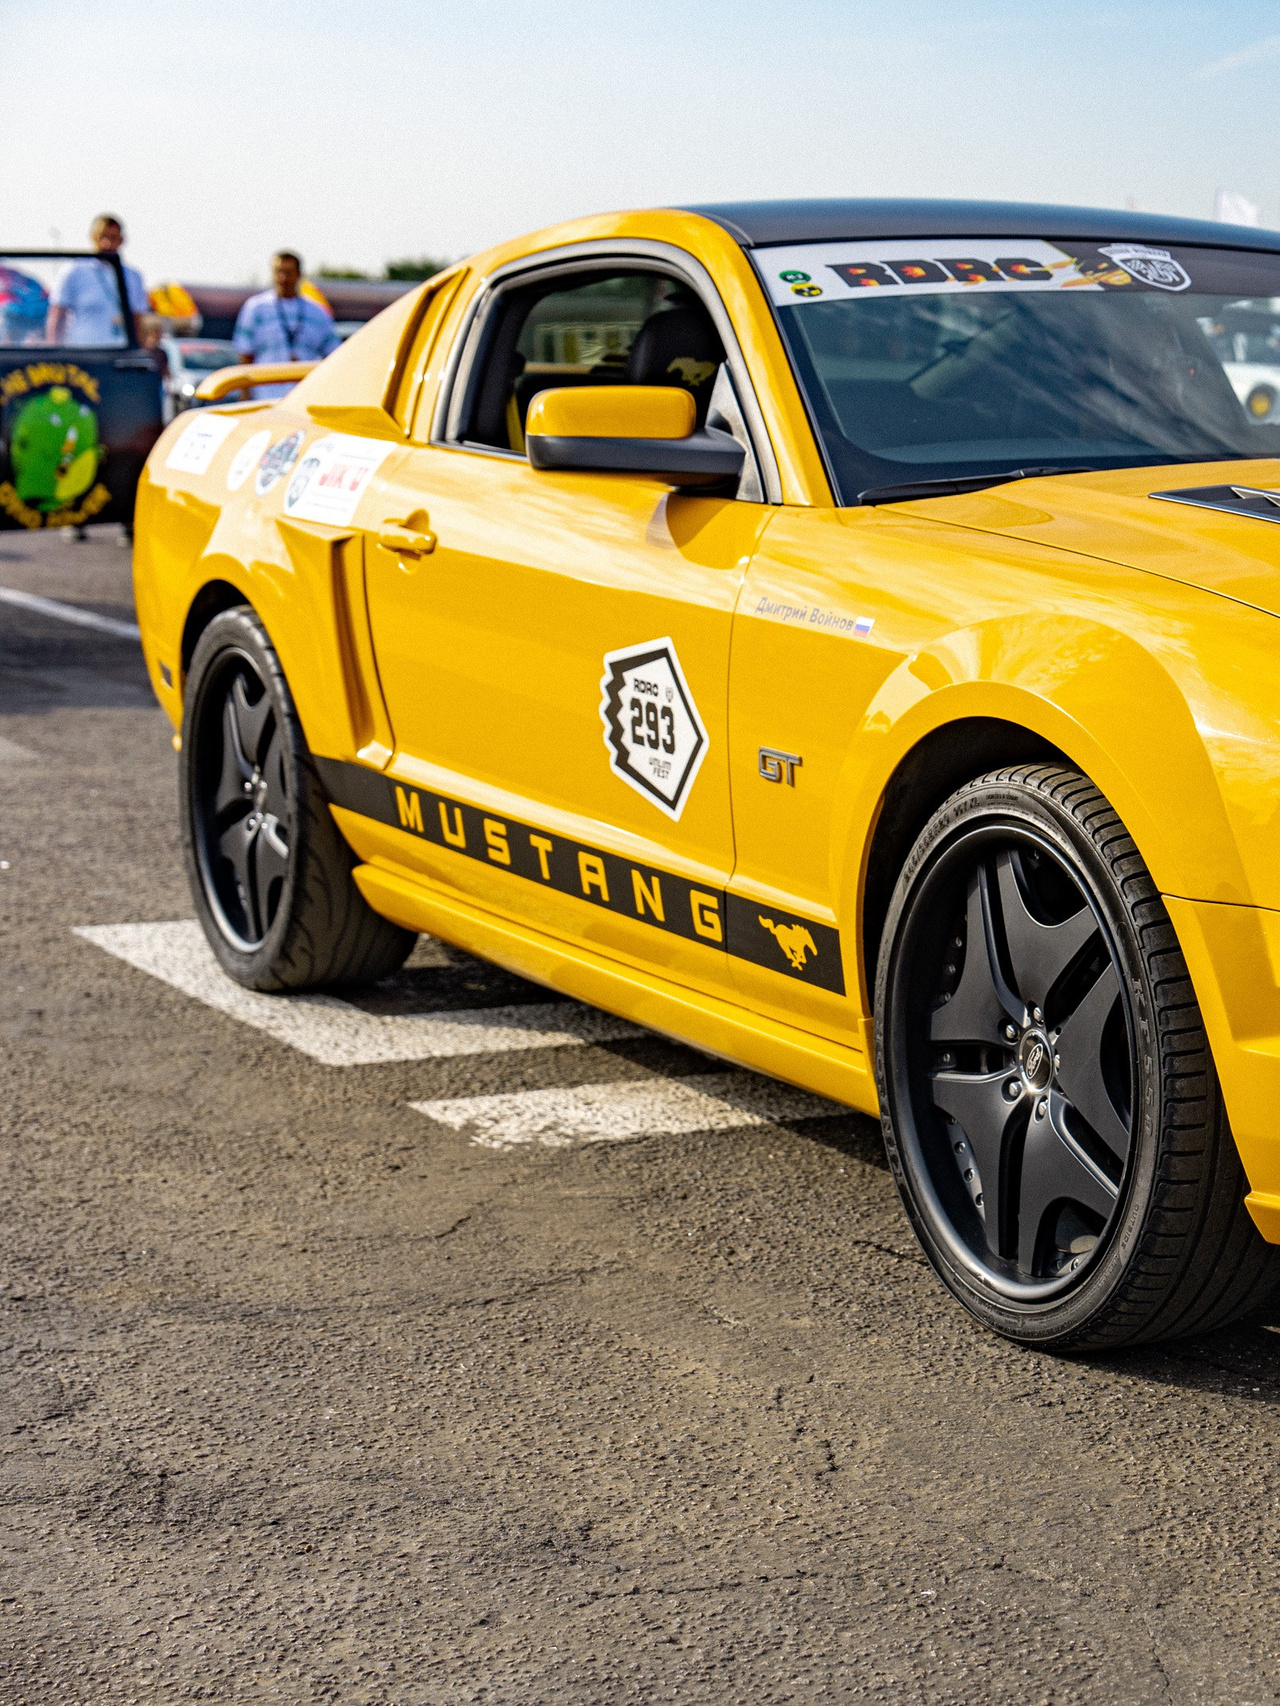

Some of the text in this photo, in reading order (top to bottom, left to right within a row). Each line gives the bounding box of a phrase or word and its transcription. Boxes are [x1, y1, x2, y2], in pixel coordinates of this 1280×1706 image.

[825, 258, 1053, 288] RDRC
[756, 597, 854, 631] Дмитрий Войнов
[630, 697, 675, 755] 293
[758, 745, 803, 788] GT
[395, 786, 723, 942] MUSTANG
[1120, 1203, 1140, 1250] OUTSIDE
